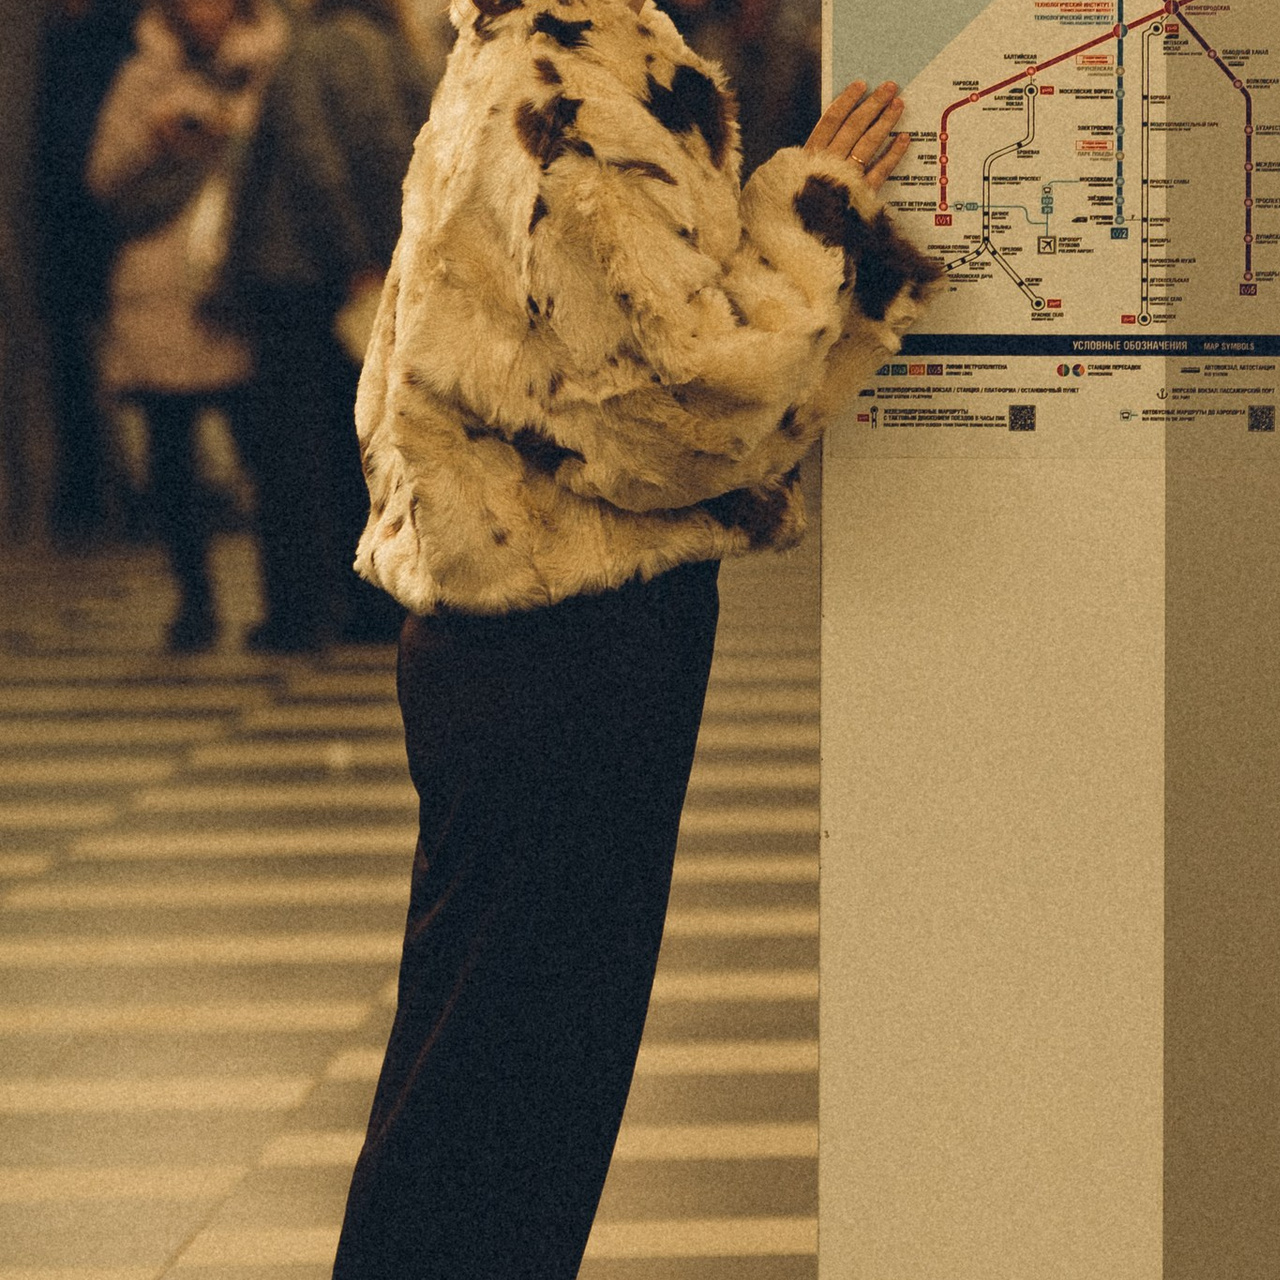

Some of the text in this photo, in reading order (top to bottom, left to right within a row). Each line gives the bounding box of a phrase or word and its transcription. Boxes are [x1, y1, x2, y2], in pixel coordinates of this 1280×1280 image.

[1072, 340, 1188, 351] УСЛОВНЫЕ ОБОЗНАЧЕНИЯ
[1203, 342, 1255, 351] MAP SYMBOLS
